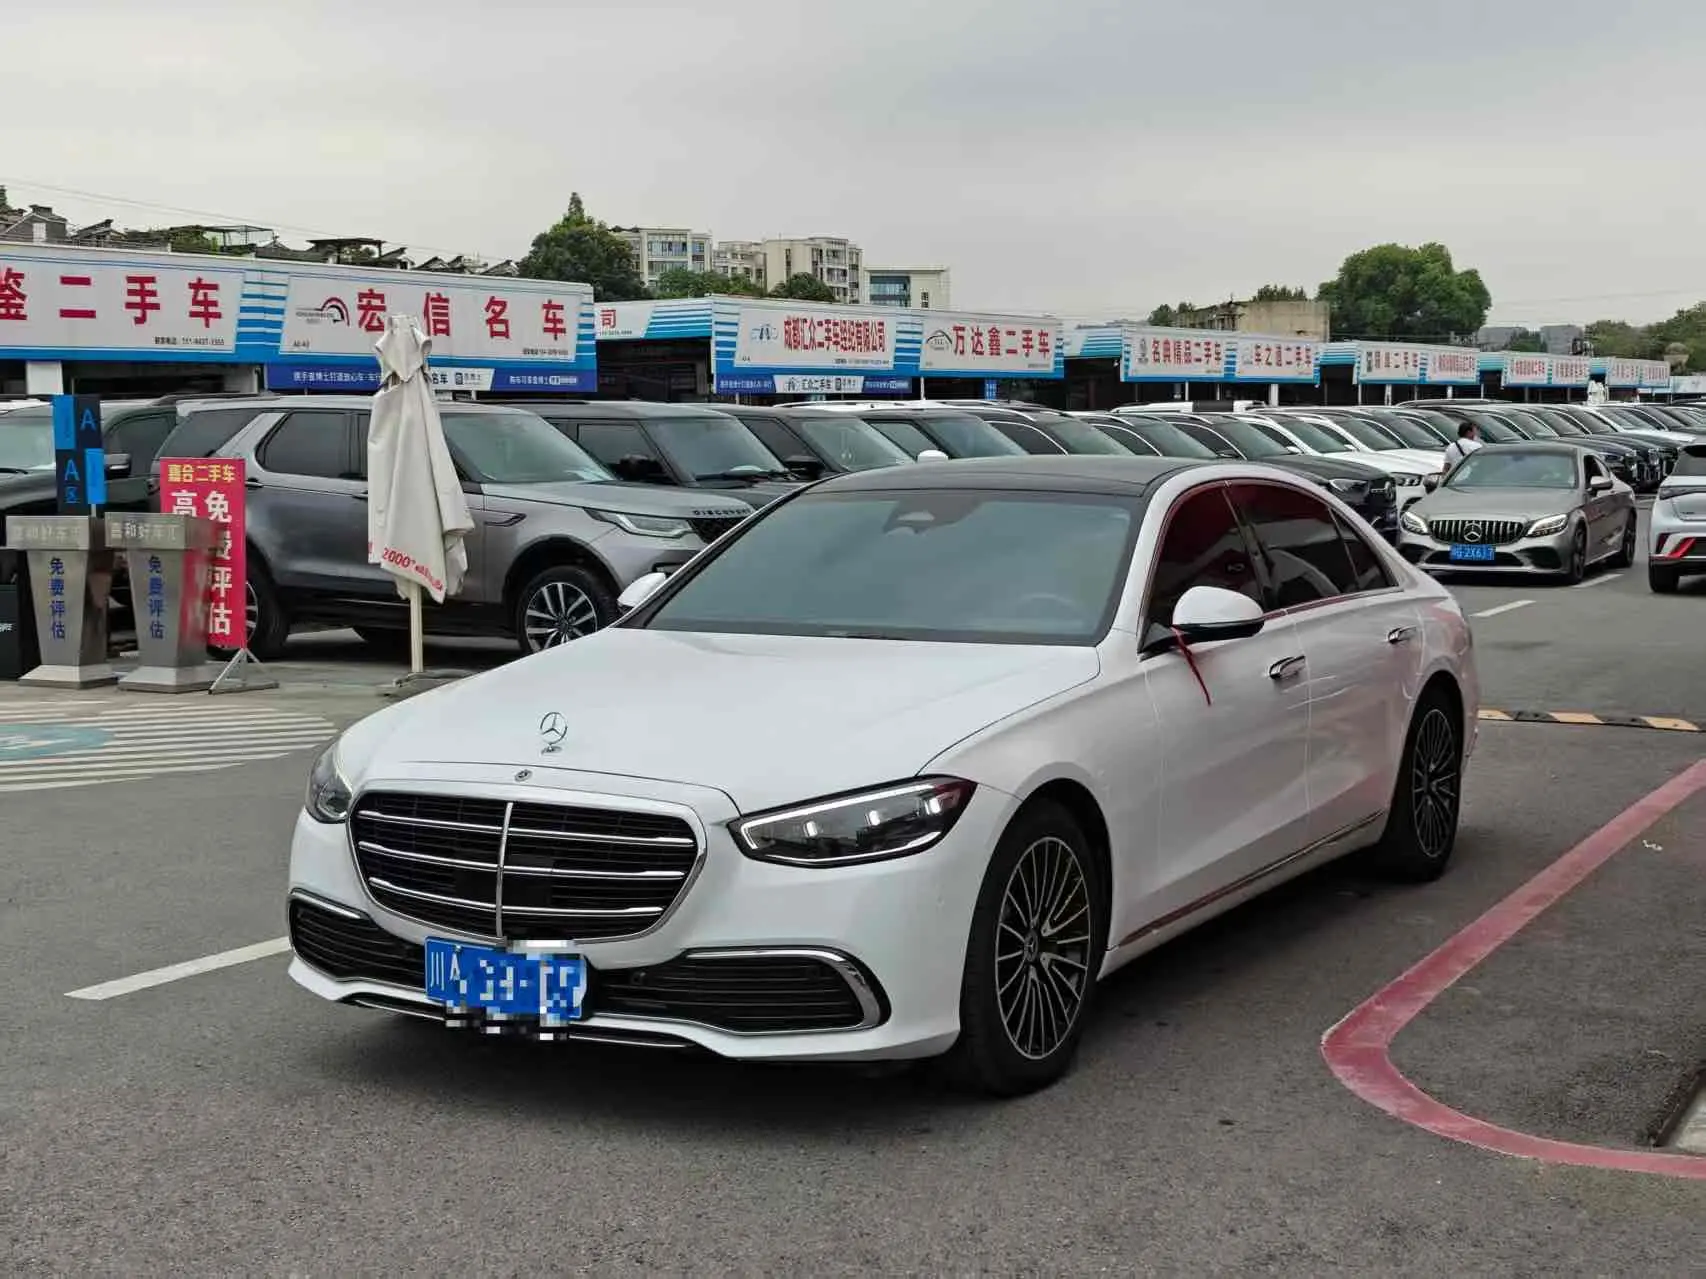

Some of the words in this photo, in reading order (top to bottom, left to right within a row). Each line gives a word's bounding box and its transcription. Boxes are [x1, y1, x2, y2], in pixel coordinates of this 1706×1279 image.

[357, 288, 567, 341] 宏信名车
[600, 309, 616, 328] 司
[953, 325, 1050, 358] 万达鑫二手车
[80, 408, 97, 431] A
